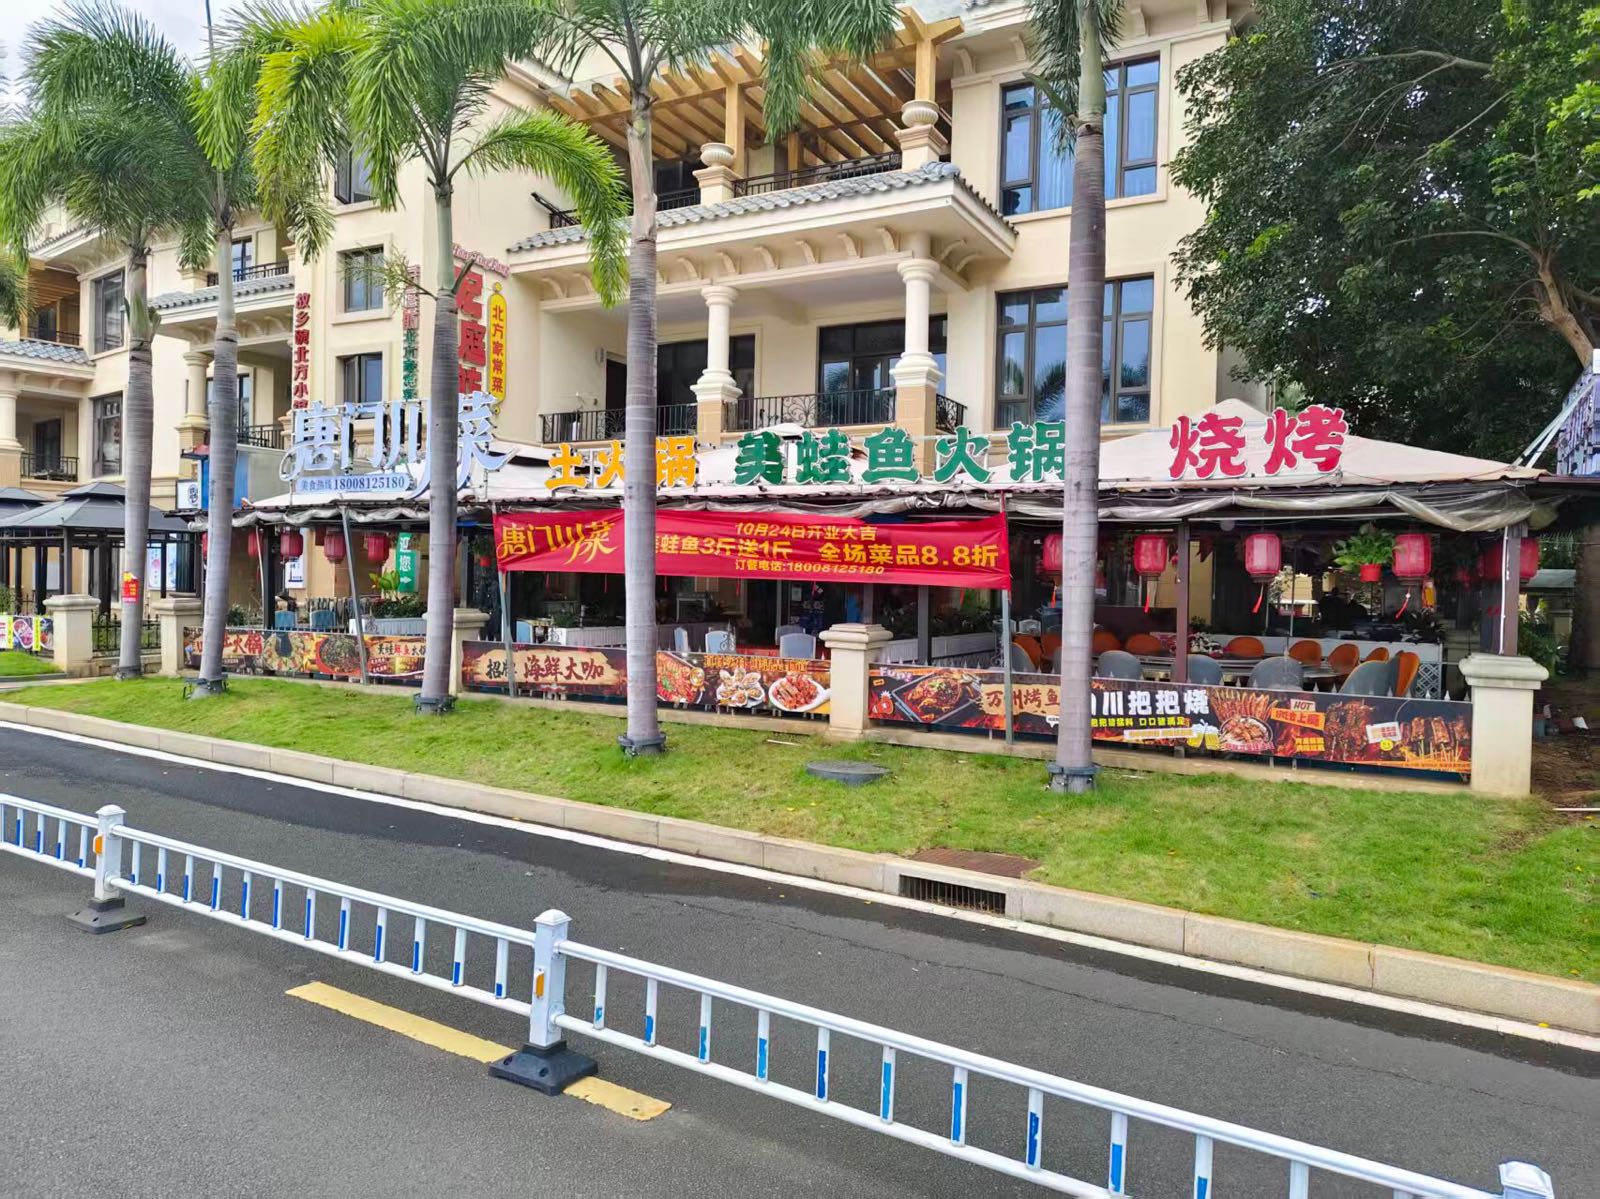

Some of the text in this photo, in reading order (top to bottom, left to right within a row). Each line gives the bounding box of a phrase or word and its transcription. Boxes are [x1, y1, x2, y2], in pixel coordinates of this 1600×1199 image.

[491, 304, 505, 393] 北方家常菜
[734, 421, 1065, 486] 美蛙鱼火锅
[1169, 403, 1349, 480] 烧烤
[495, 521, 618, 565] 唐门川菜
[735, 522, 878, 542] 10月24日开业大吉
[818, 543, 999, 567] 全场菜品8.8折
[524, 655, 605, 682] 海鲜大咖
[1090, 689, 1210, 716] 川把把烧
[1293, 700, 1314, 710] HOT
